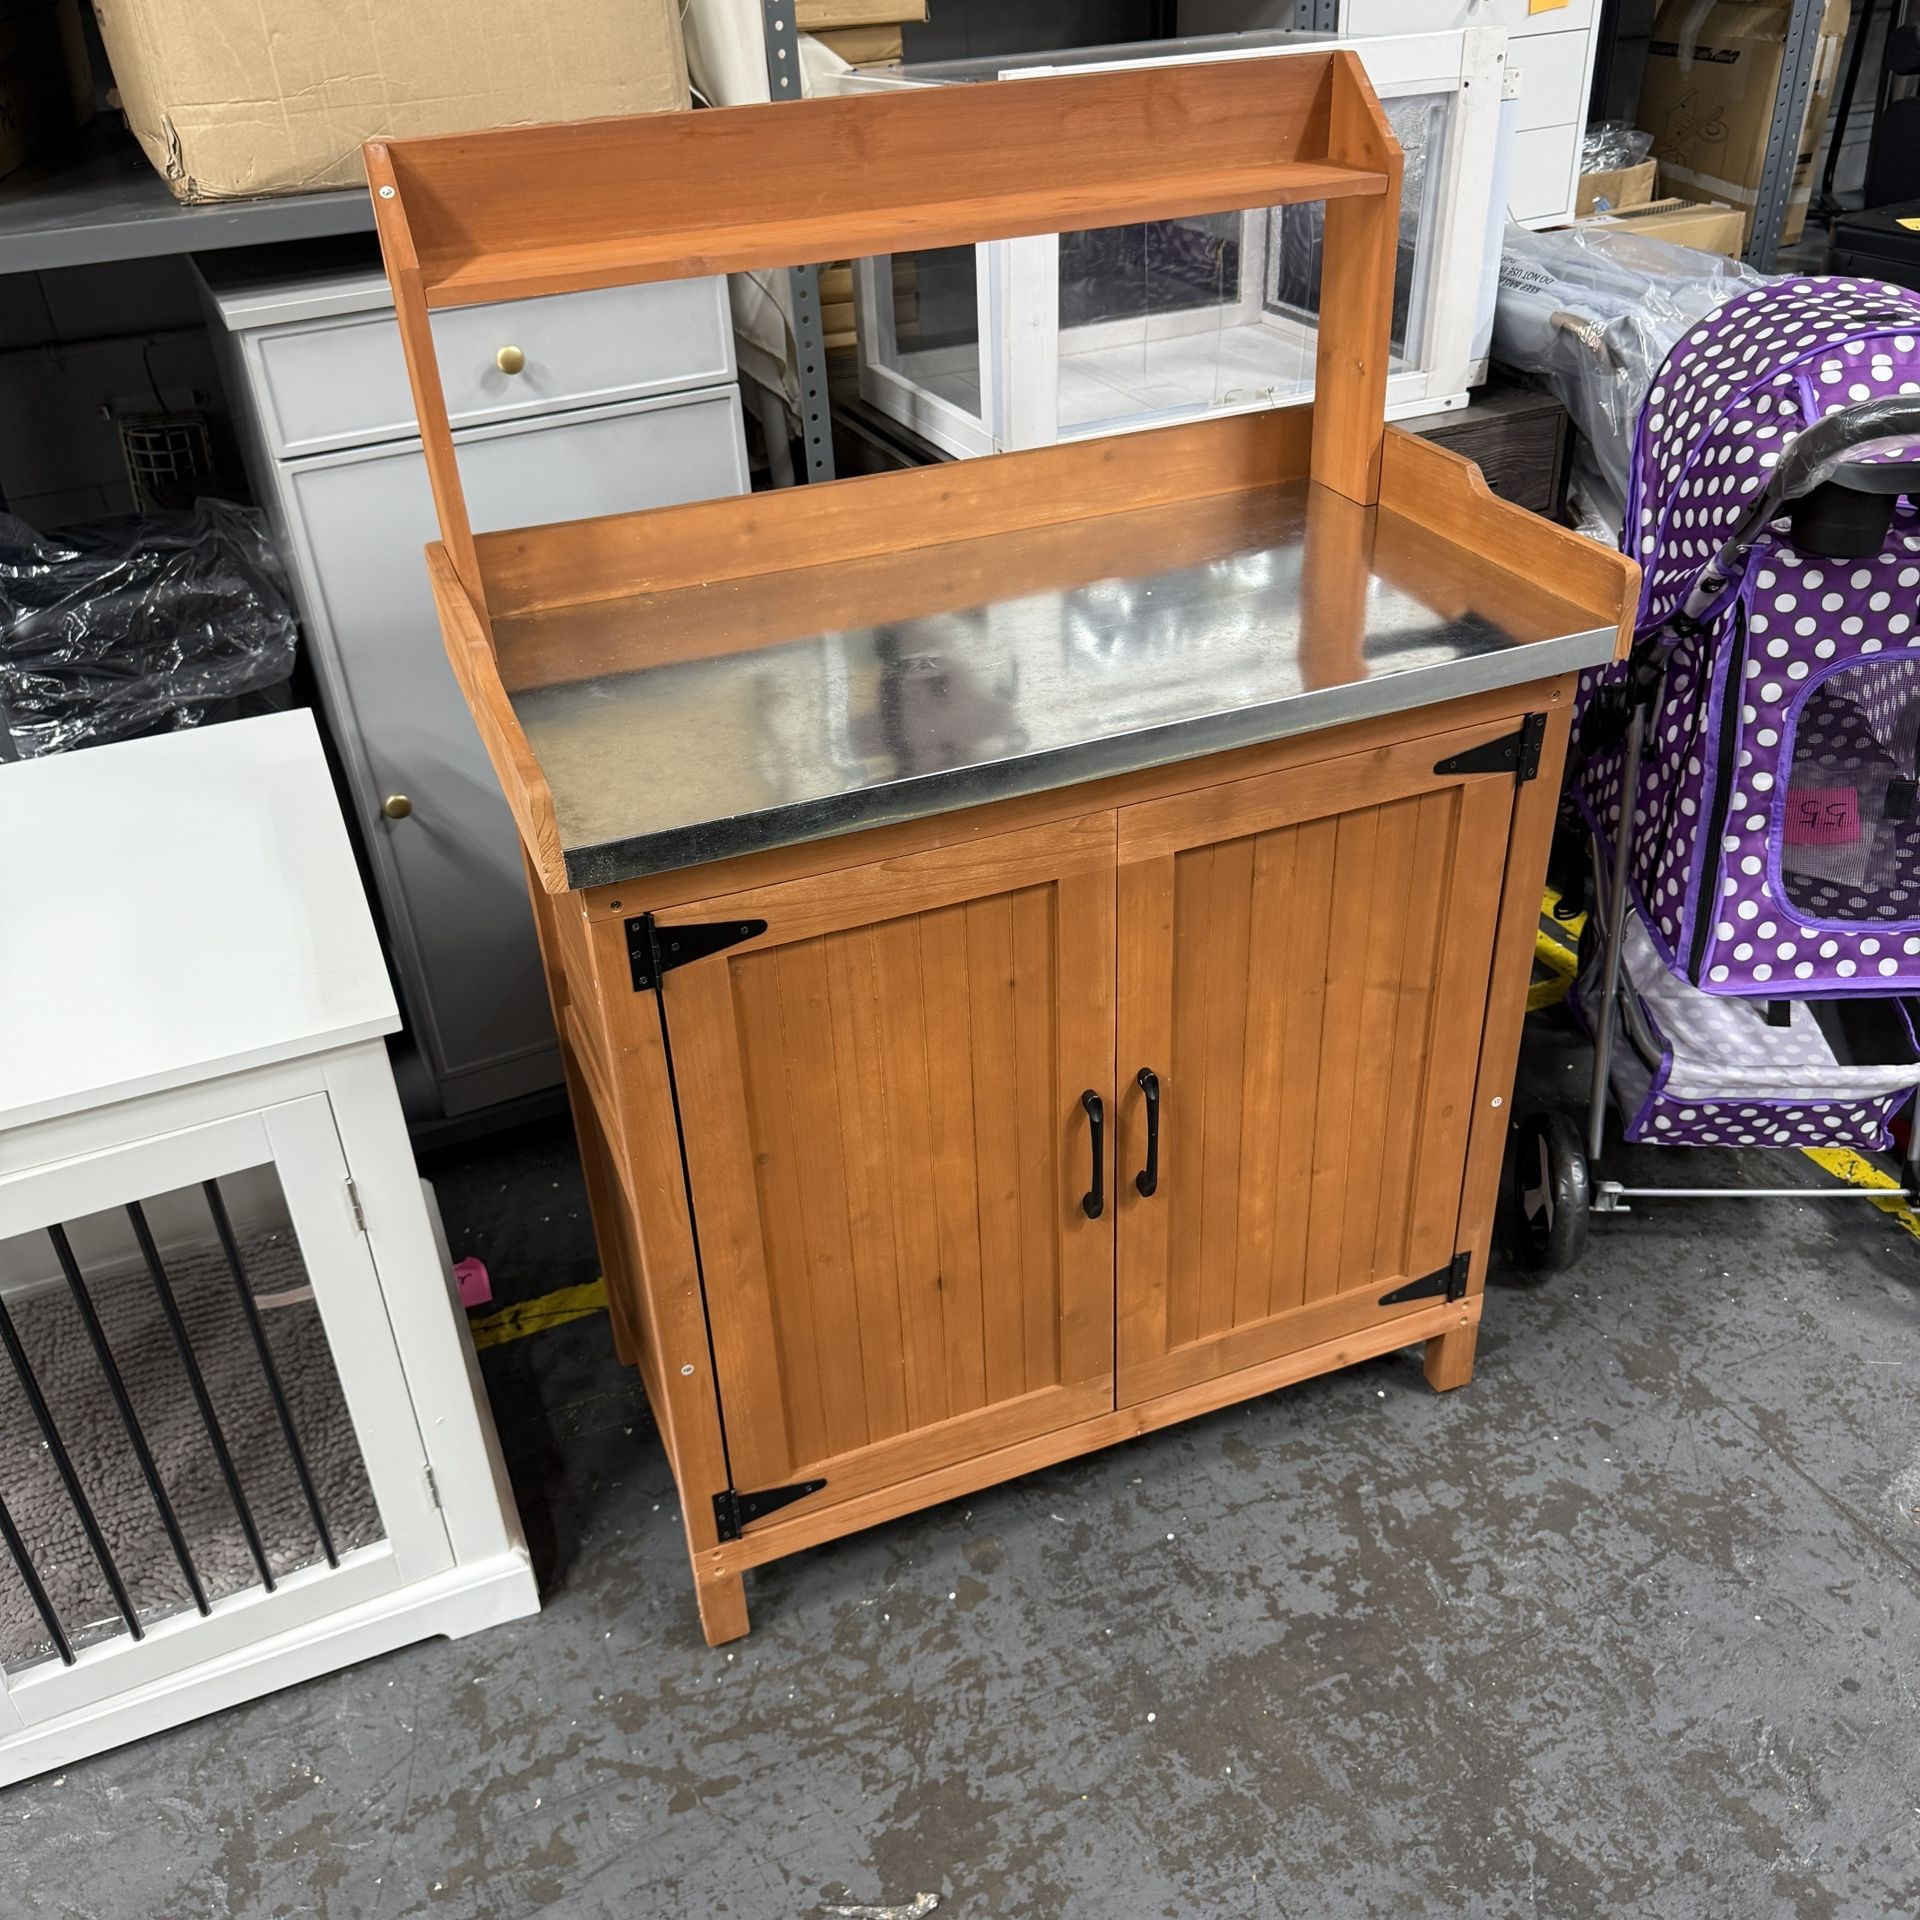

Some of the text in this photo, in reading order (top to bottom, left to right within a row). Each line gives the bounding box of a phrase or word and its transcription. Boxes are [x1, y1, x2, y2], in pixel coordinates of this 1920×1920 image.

[1507, 267, 1524, 278] USE
[1521, 271, 1541, 283] NOT
[1519, 283, 1541, 294] KEEP
